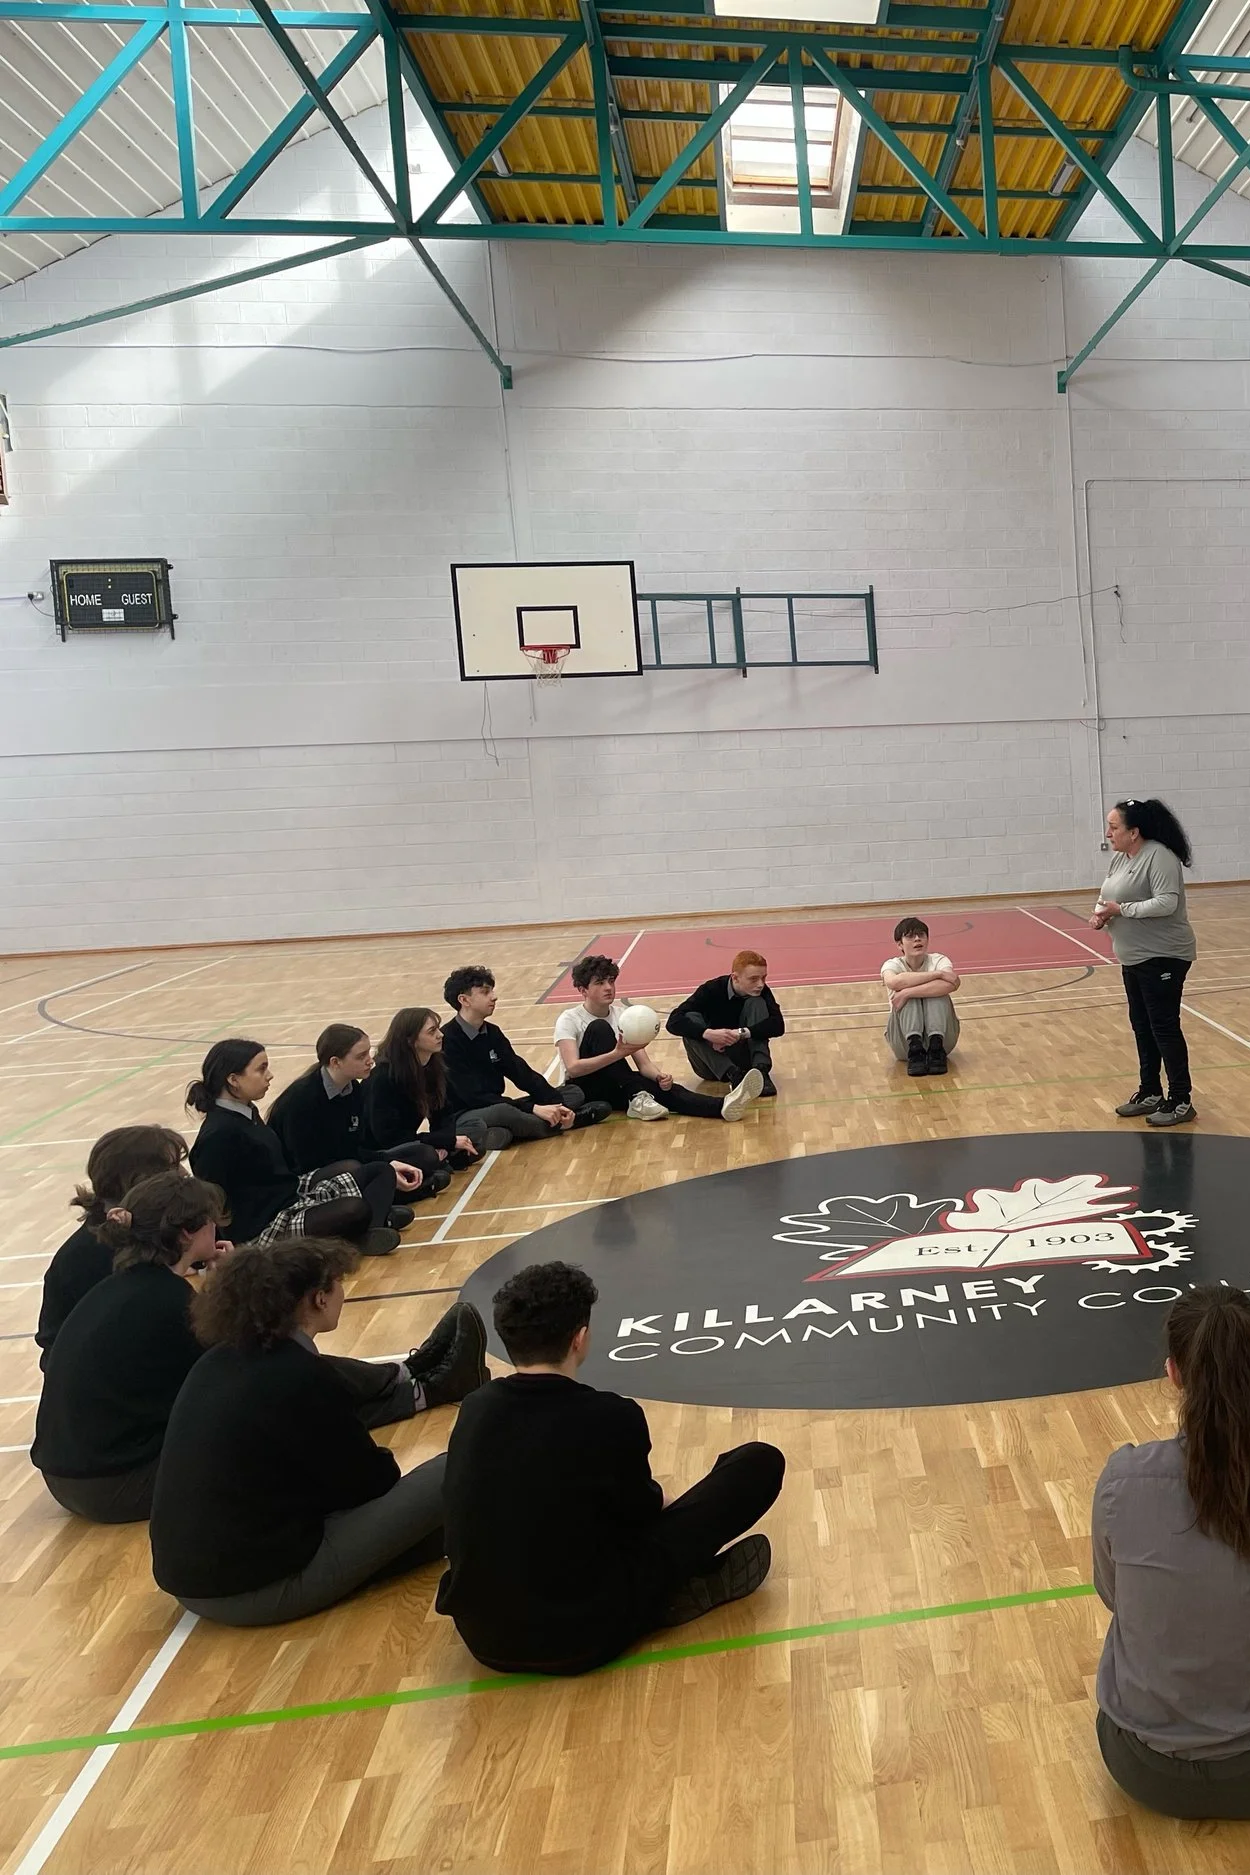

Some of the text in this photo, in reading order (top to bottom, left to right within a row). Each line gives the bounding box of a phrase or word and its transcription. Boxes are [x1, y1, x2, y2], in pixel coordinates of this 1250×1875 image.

[69, 593, 152, 606] HOME GUEST
[915, 1232, 1115, 1257] Est. 1903
[617, 1274, 1045, 1337] KILLARNEY
[608, 1299, 1047, 1361] COMMUNITY
